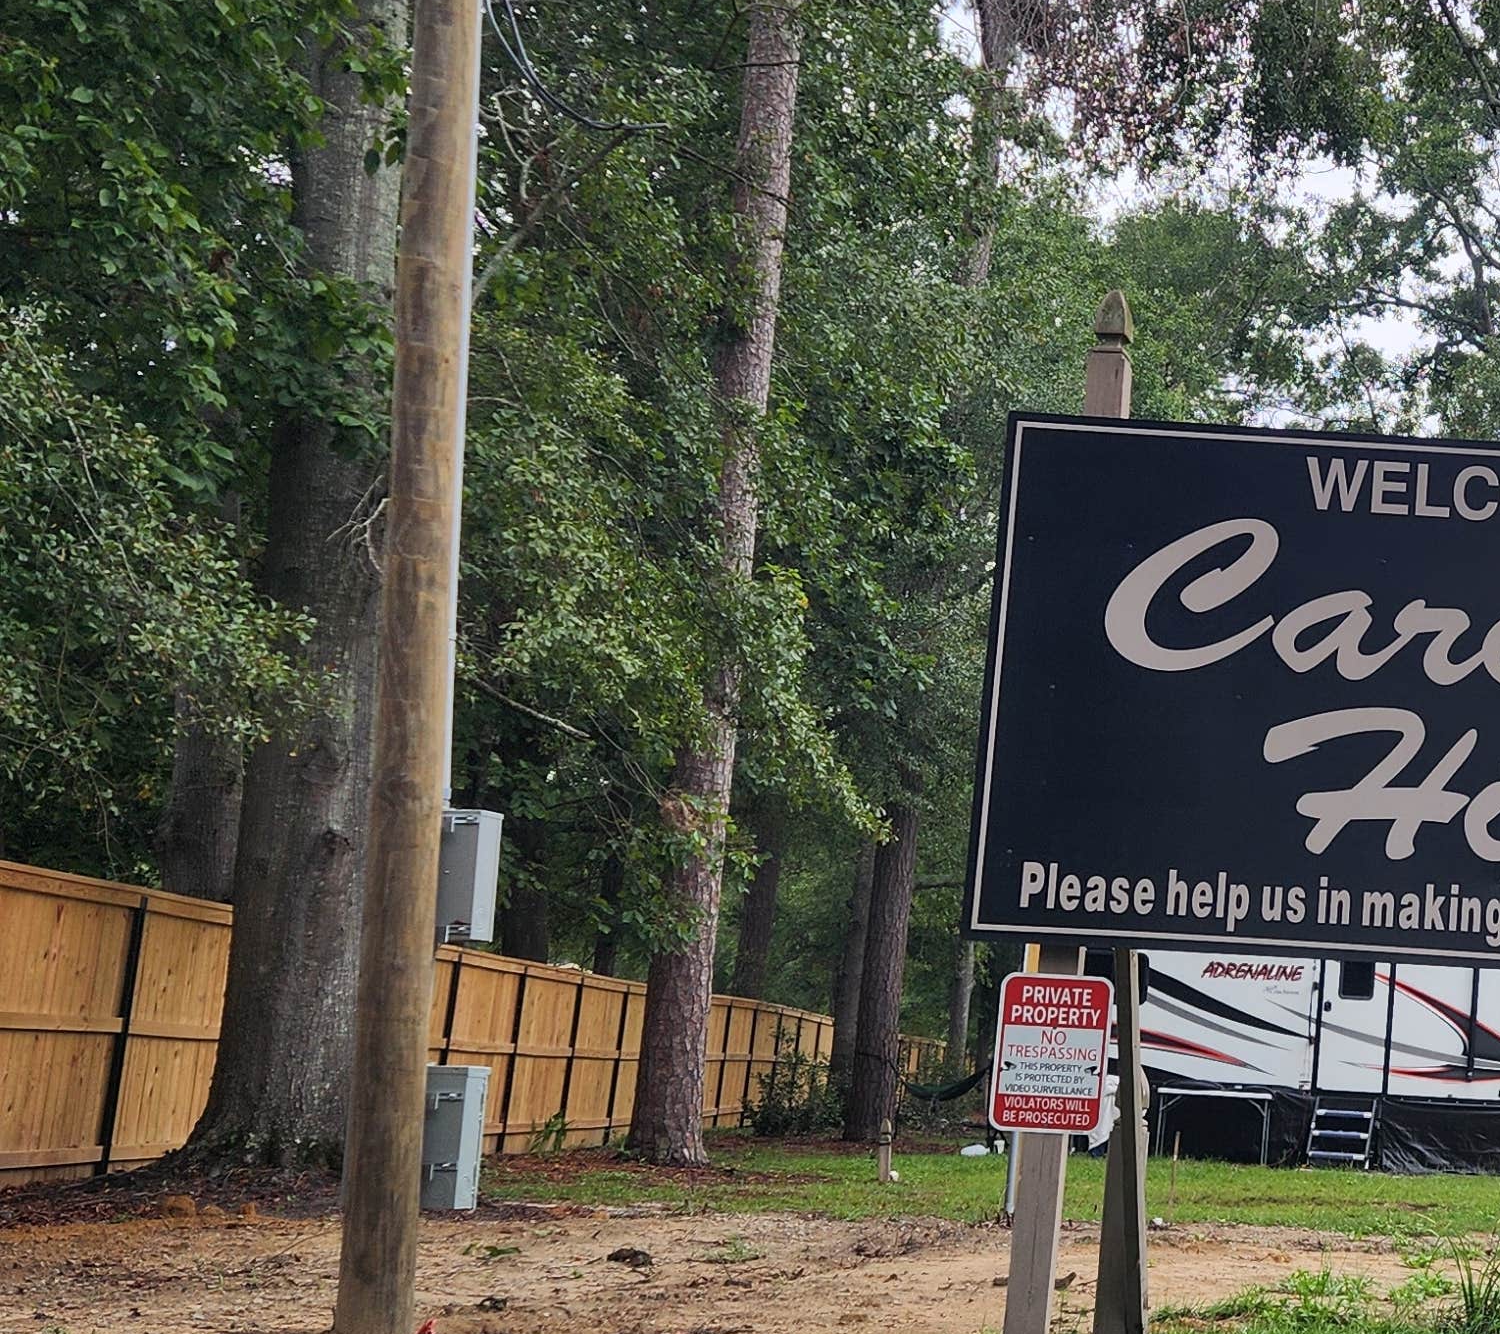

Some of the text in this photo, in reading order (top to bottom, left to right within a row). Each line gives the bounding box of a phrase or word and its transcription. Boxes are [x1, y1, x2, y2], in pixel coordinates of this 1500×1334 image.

[1019, 861, 1155, 916] Please
[1166, 869, 1250, 932] help
[1261, 885, 1306, 924] us
[1317, 876, 1351, 925] in
[1201, 961, 1304, 982] ADRENALINE
[1022, 985, 1092, 1006] PRIVATE
[1010, 1005, 1101, 1026] PROPERTY
[1041, 1030, 1067, 1045] NO
[1008, 1044, 1097, 1062] TRESPASSING
[1020, 1061, 1082, 1073] THIS PROPERTY
[1015, 1072, 1084, 1085] IS PROTECTED BY
[1005, 1083, 1092, 1096] VIDEO SURVEILLANCE
[1004, 1096, 1091, 1112] VIOLATORS WILL
[1002, 1110, 1090, 1126] BE PROSECUTED
